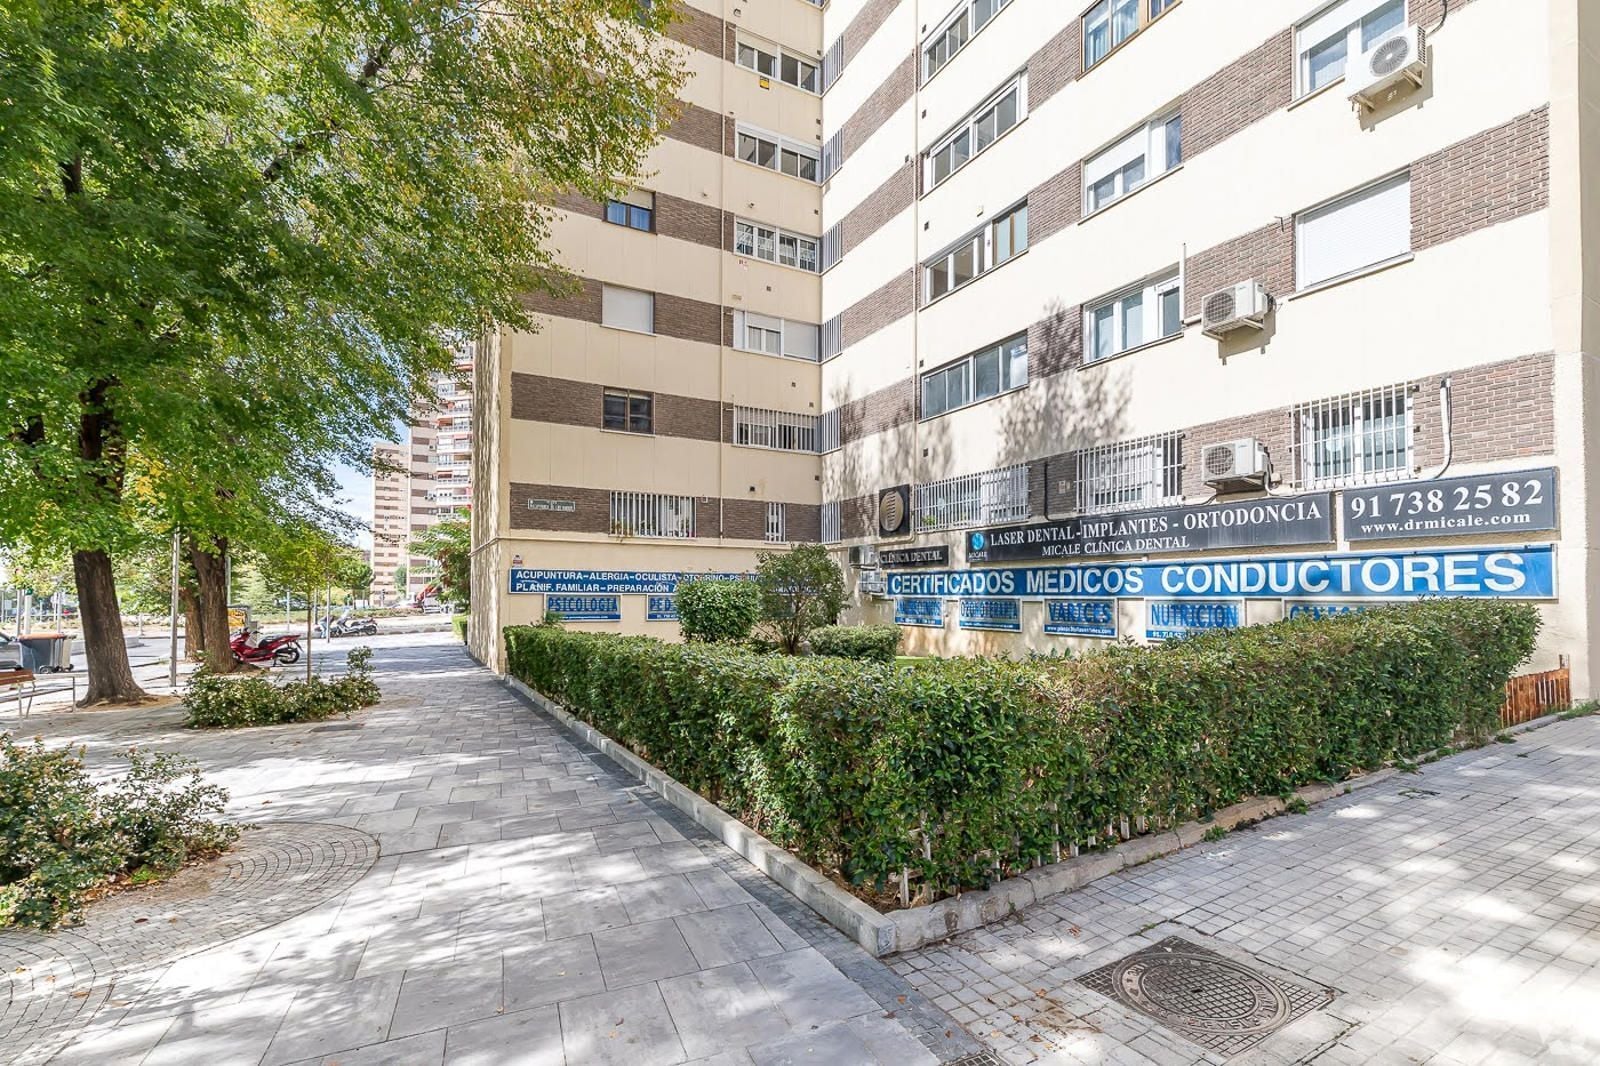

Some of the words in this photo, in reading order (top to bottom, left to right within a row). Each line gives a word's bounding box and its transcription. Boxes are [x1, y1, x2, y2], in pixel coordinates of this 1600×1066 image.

[1351, 495, 1381, 520] 91
[1389, 488, 1444, 516] 738
[1453, 483, 1492, 511] 25
[1501, 479, 1544, 507] 82
[990, 530, 1025, 546] LASER
[1083, 516, 1168, 539] IMPLANTES
[1183, 500, 1322, 530] ORTODONCIA
[1360, 511, 1531, 534] www.drmicale.com
[911, 550, 943, 562] DENTAL
[1042, 544, 1081, 556] MICALE
[1084, 539, 1132, 554] CLÍNICA
[1135, 536, 1190, 550] DENTAL
[891, 570, 1015, 594] CERTIFICADOS
[1026, 567, 1144, 593] MEDICOS
[1161, 551, 1526, 594] CONDUCTORES
[516, 583, 554, 592] PLANIF.
[1048, 601, 1112, 624] VARICES
[1151, 604, 1240, 628] NUTRICION
